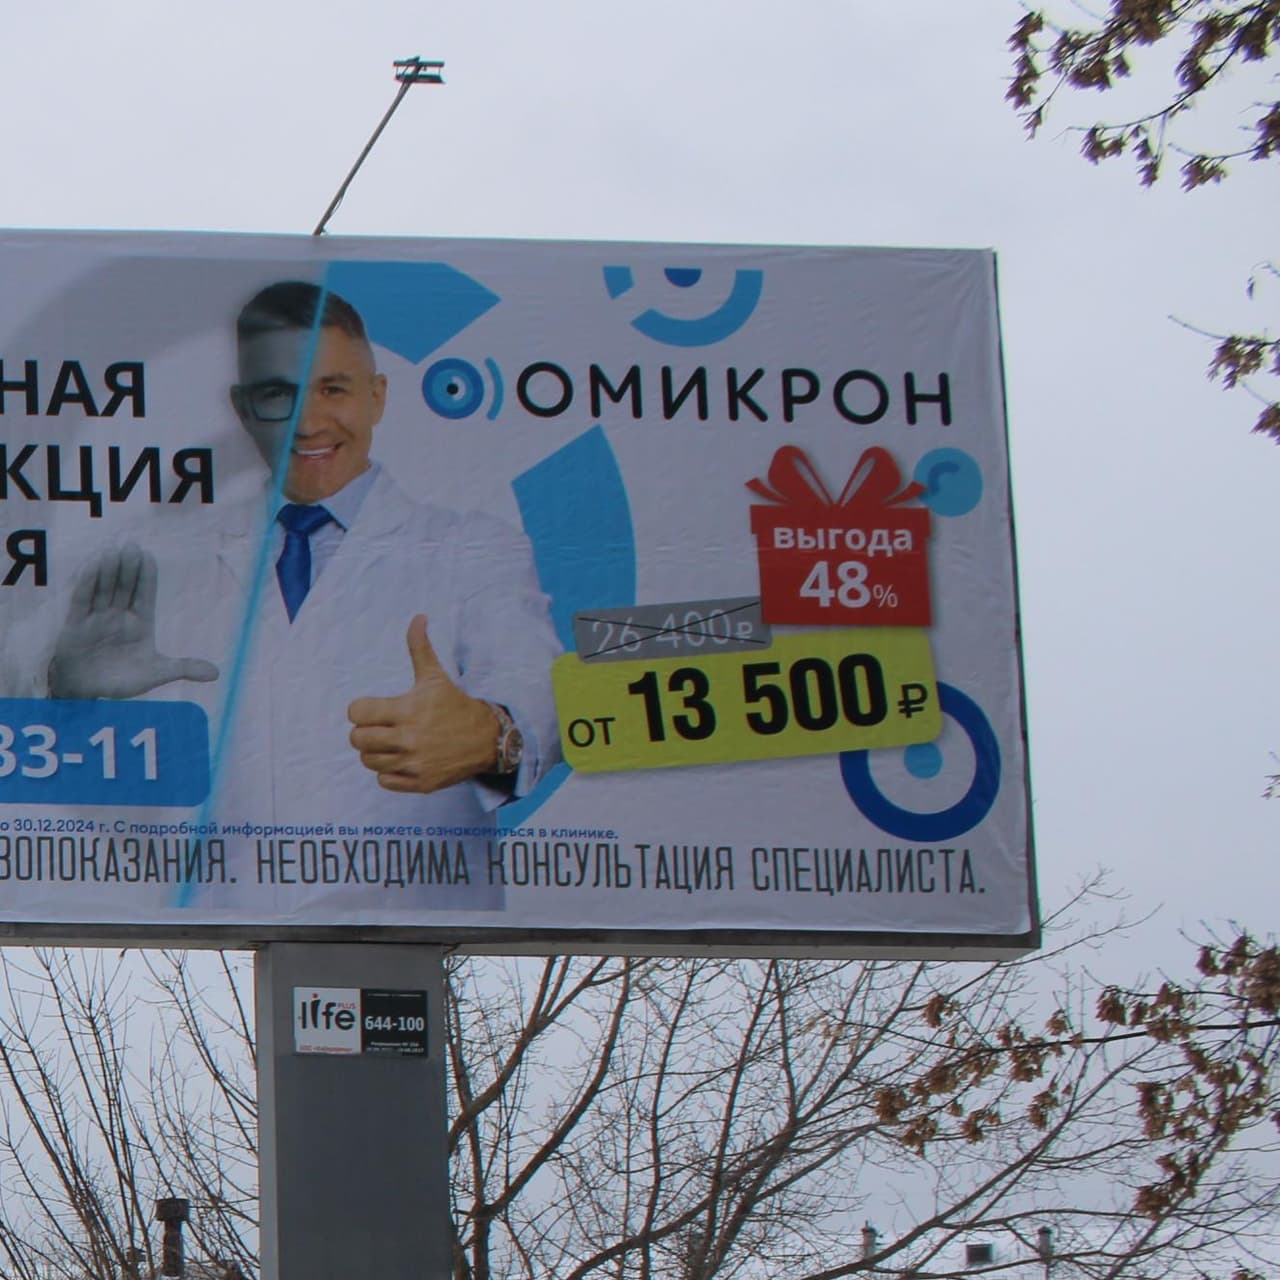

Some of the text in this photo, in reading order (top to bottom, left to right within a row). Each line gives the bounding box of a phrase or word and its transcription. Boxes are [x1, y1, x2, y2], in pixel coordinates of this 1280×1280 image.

[515, 361, 953, 427] ОМИКРОН
[773, 525, 913, 558] выгода
[627, 667, 716, 742] 13
[13, 819, 95, 833] 30.12.2024
[98, 822, 110, 833] г.
[129, 821, 218, 838] подробной
[222, 821, 334, 839] информацией
[338, 825, 360, 837] вы
[363, 825, 422, 838] можете
[425, 826, 535, 839] ознакомиться
[551, 828, 620, 841] клинике.
[256, 839, 471, 889] НЕОБХОДИМА
[487, 841, 734, 894] КОНСУЛЬТАЦИЯ
[751, 846, 987, 896] СПЕЦИАЛИСТА.
[364, 1015, 425, 1032] 644-100
